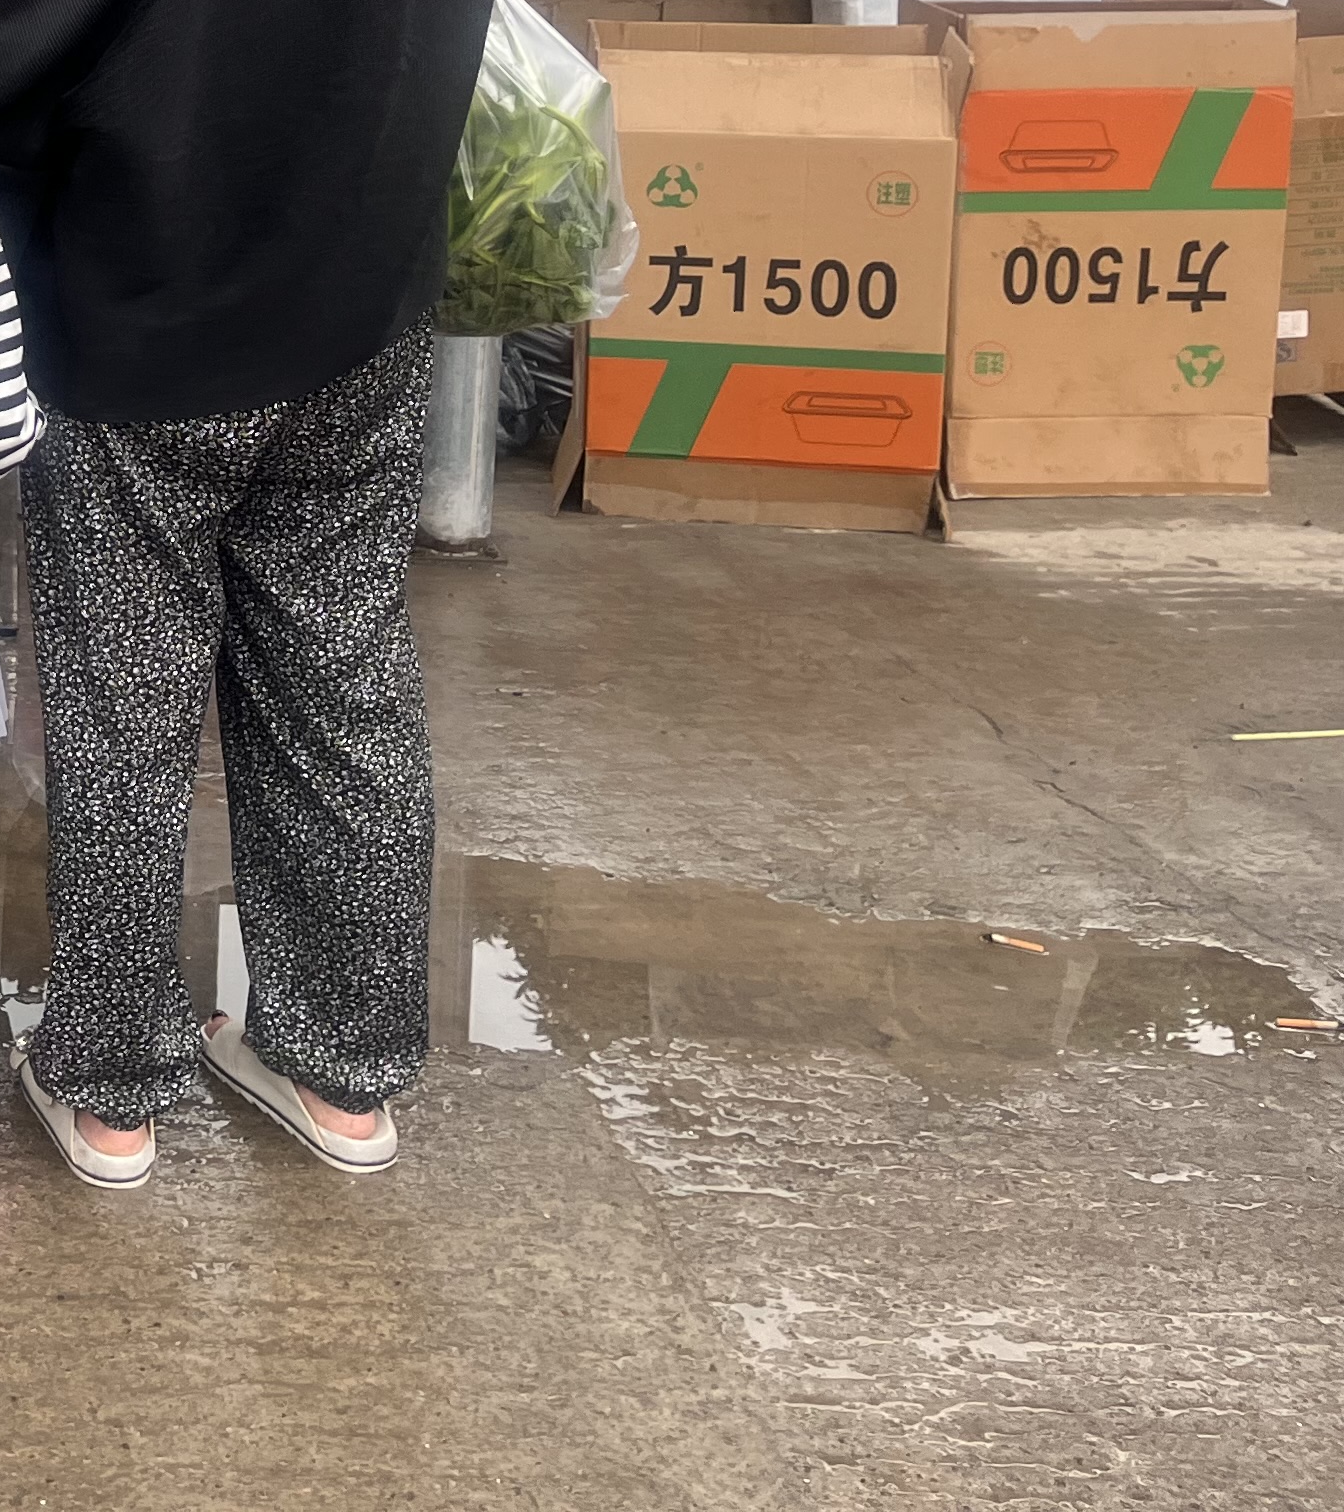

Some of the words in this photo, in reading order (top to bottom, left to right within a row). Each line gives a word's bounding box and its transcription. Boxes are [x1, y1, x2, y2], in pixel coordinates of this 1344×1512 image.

[876, 181, 911, 206] 注塑
[648, 246, 898, 320] 方1500
[1003, 240, 1231, 313] 方1500
